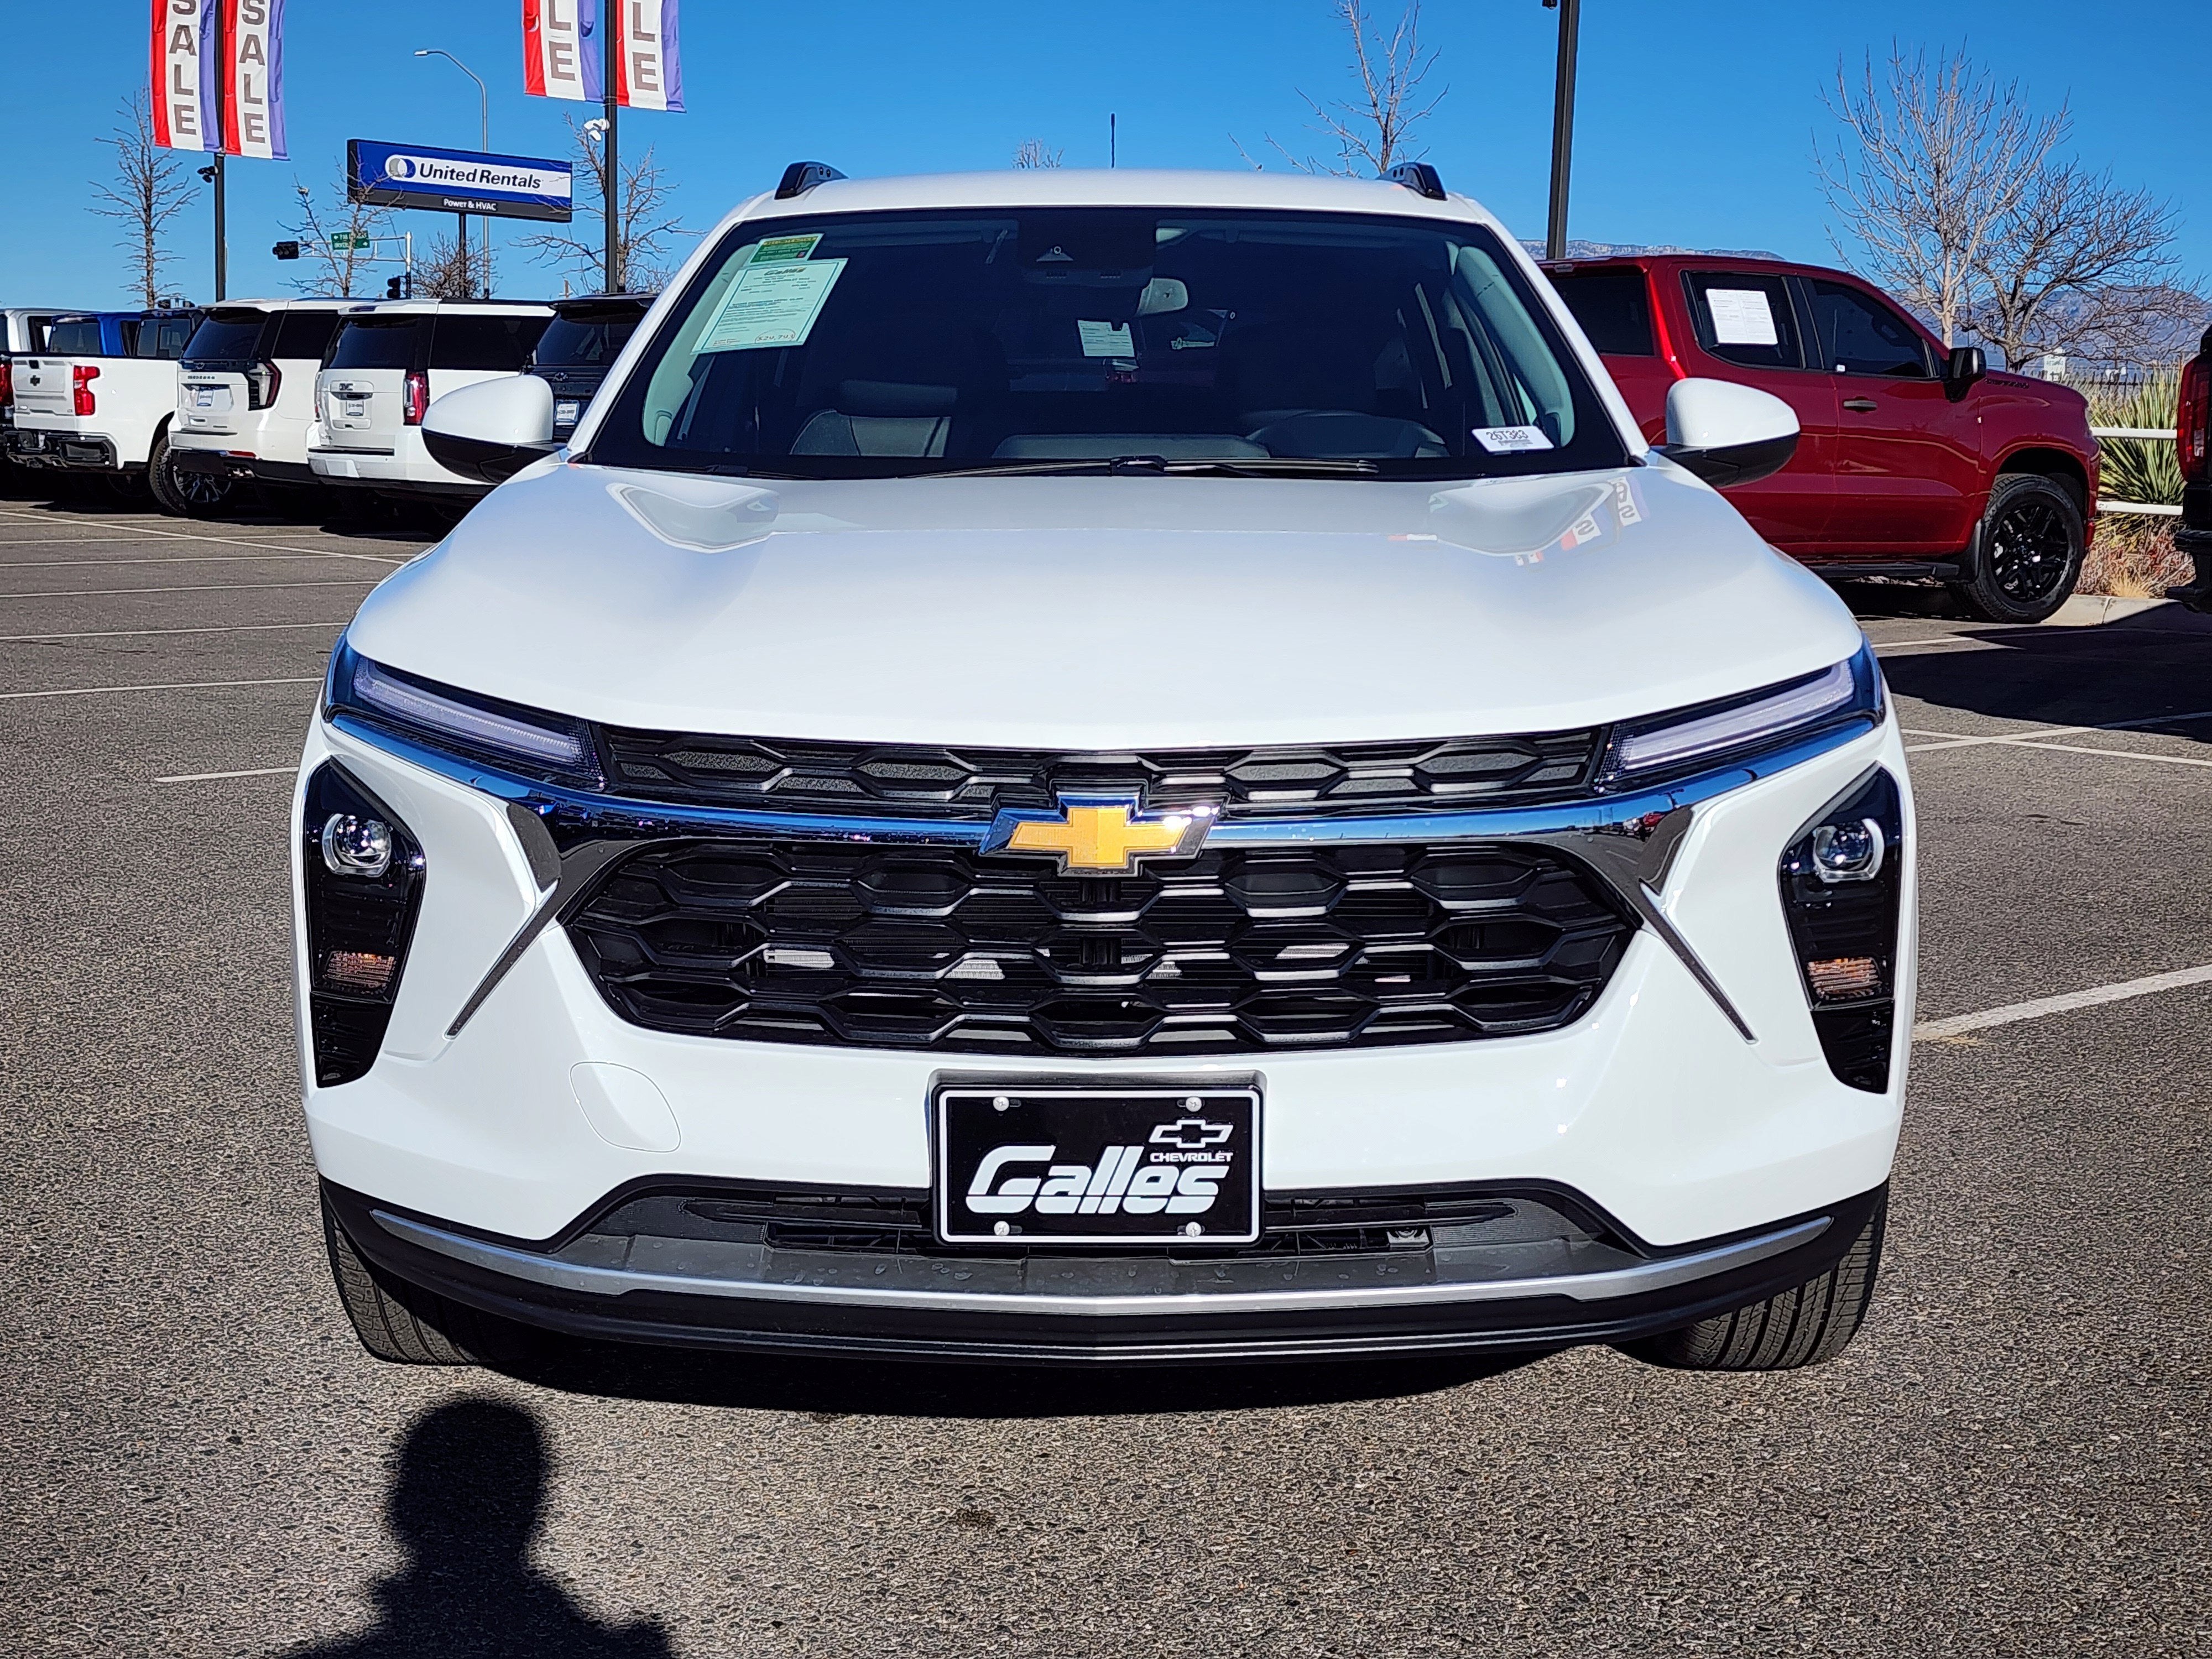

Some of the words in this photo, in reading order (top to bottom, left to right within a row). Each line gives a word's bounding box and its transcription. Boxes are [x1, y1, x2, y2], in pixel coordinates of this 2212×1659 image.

[239, 0, 265, 144] SALE
[420, 163, 477, 182] United
[479, 169, 541, 189] Rentals
[444, 199, 467, 208] Power
[476, 201, 496, 211] HVAC
[966, 1145, 1230, 1214] Galles
